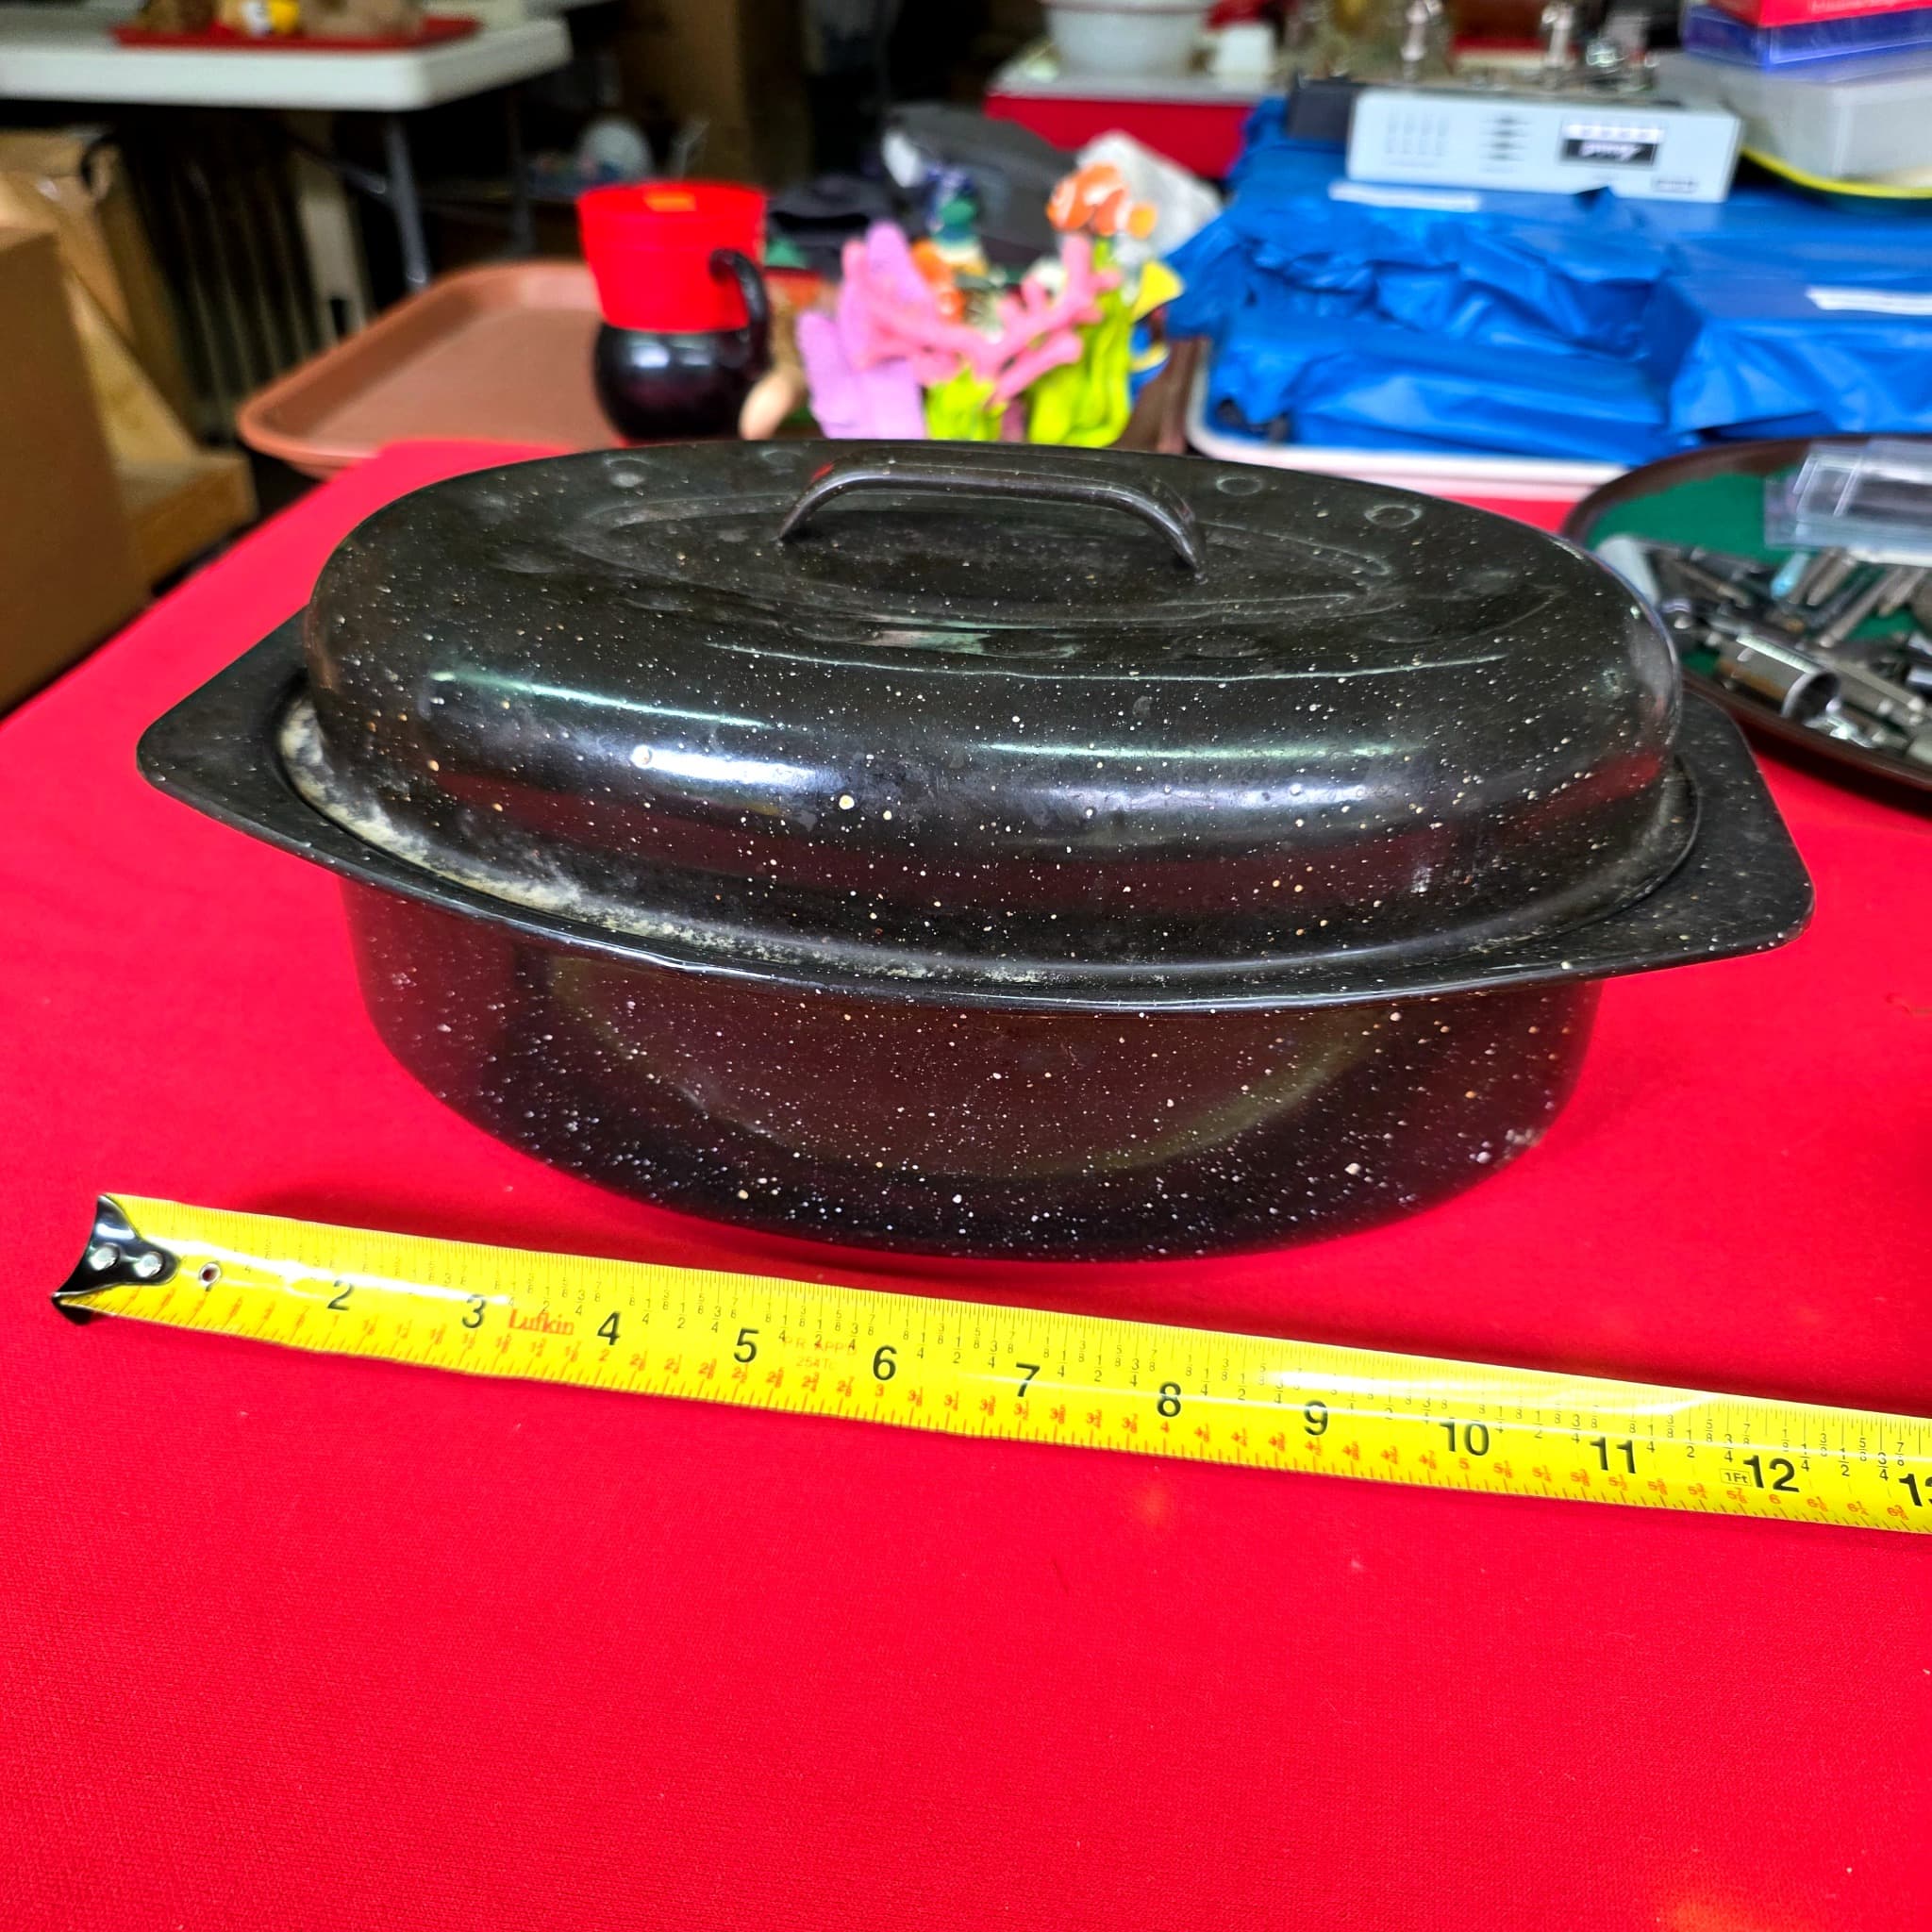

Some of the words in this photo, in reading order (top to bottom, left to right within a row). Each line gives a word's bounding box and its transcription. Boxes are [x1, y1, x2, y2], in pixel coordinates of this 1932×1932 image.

[508, 1308, 575, 1336] Lufkin
[327, 1279, 354, 1310] 2
[462, 1294, 486, 1328] 3
[597, 1311, 621, 1345] 4
[734, 1328, 758, 1362] 5
[873, 1345, 897, 1380] 6
[1016, 1362, 1040, 1397] 7
[1158, 1381, 1181, 1417] 8
[1304, 1400, 1328, 1436] 9
[1440, 1417, 1489, 1457] 10
[1590, 1436, 1636, 1474] 11
[1743, 1455, 1799, 1492] 12
[1724, 1472, 1748, 1484] 1Ft
